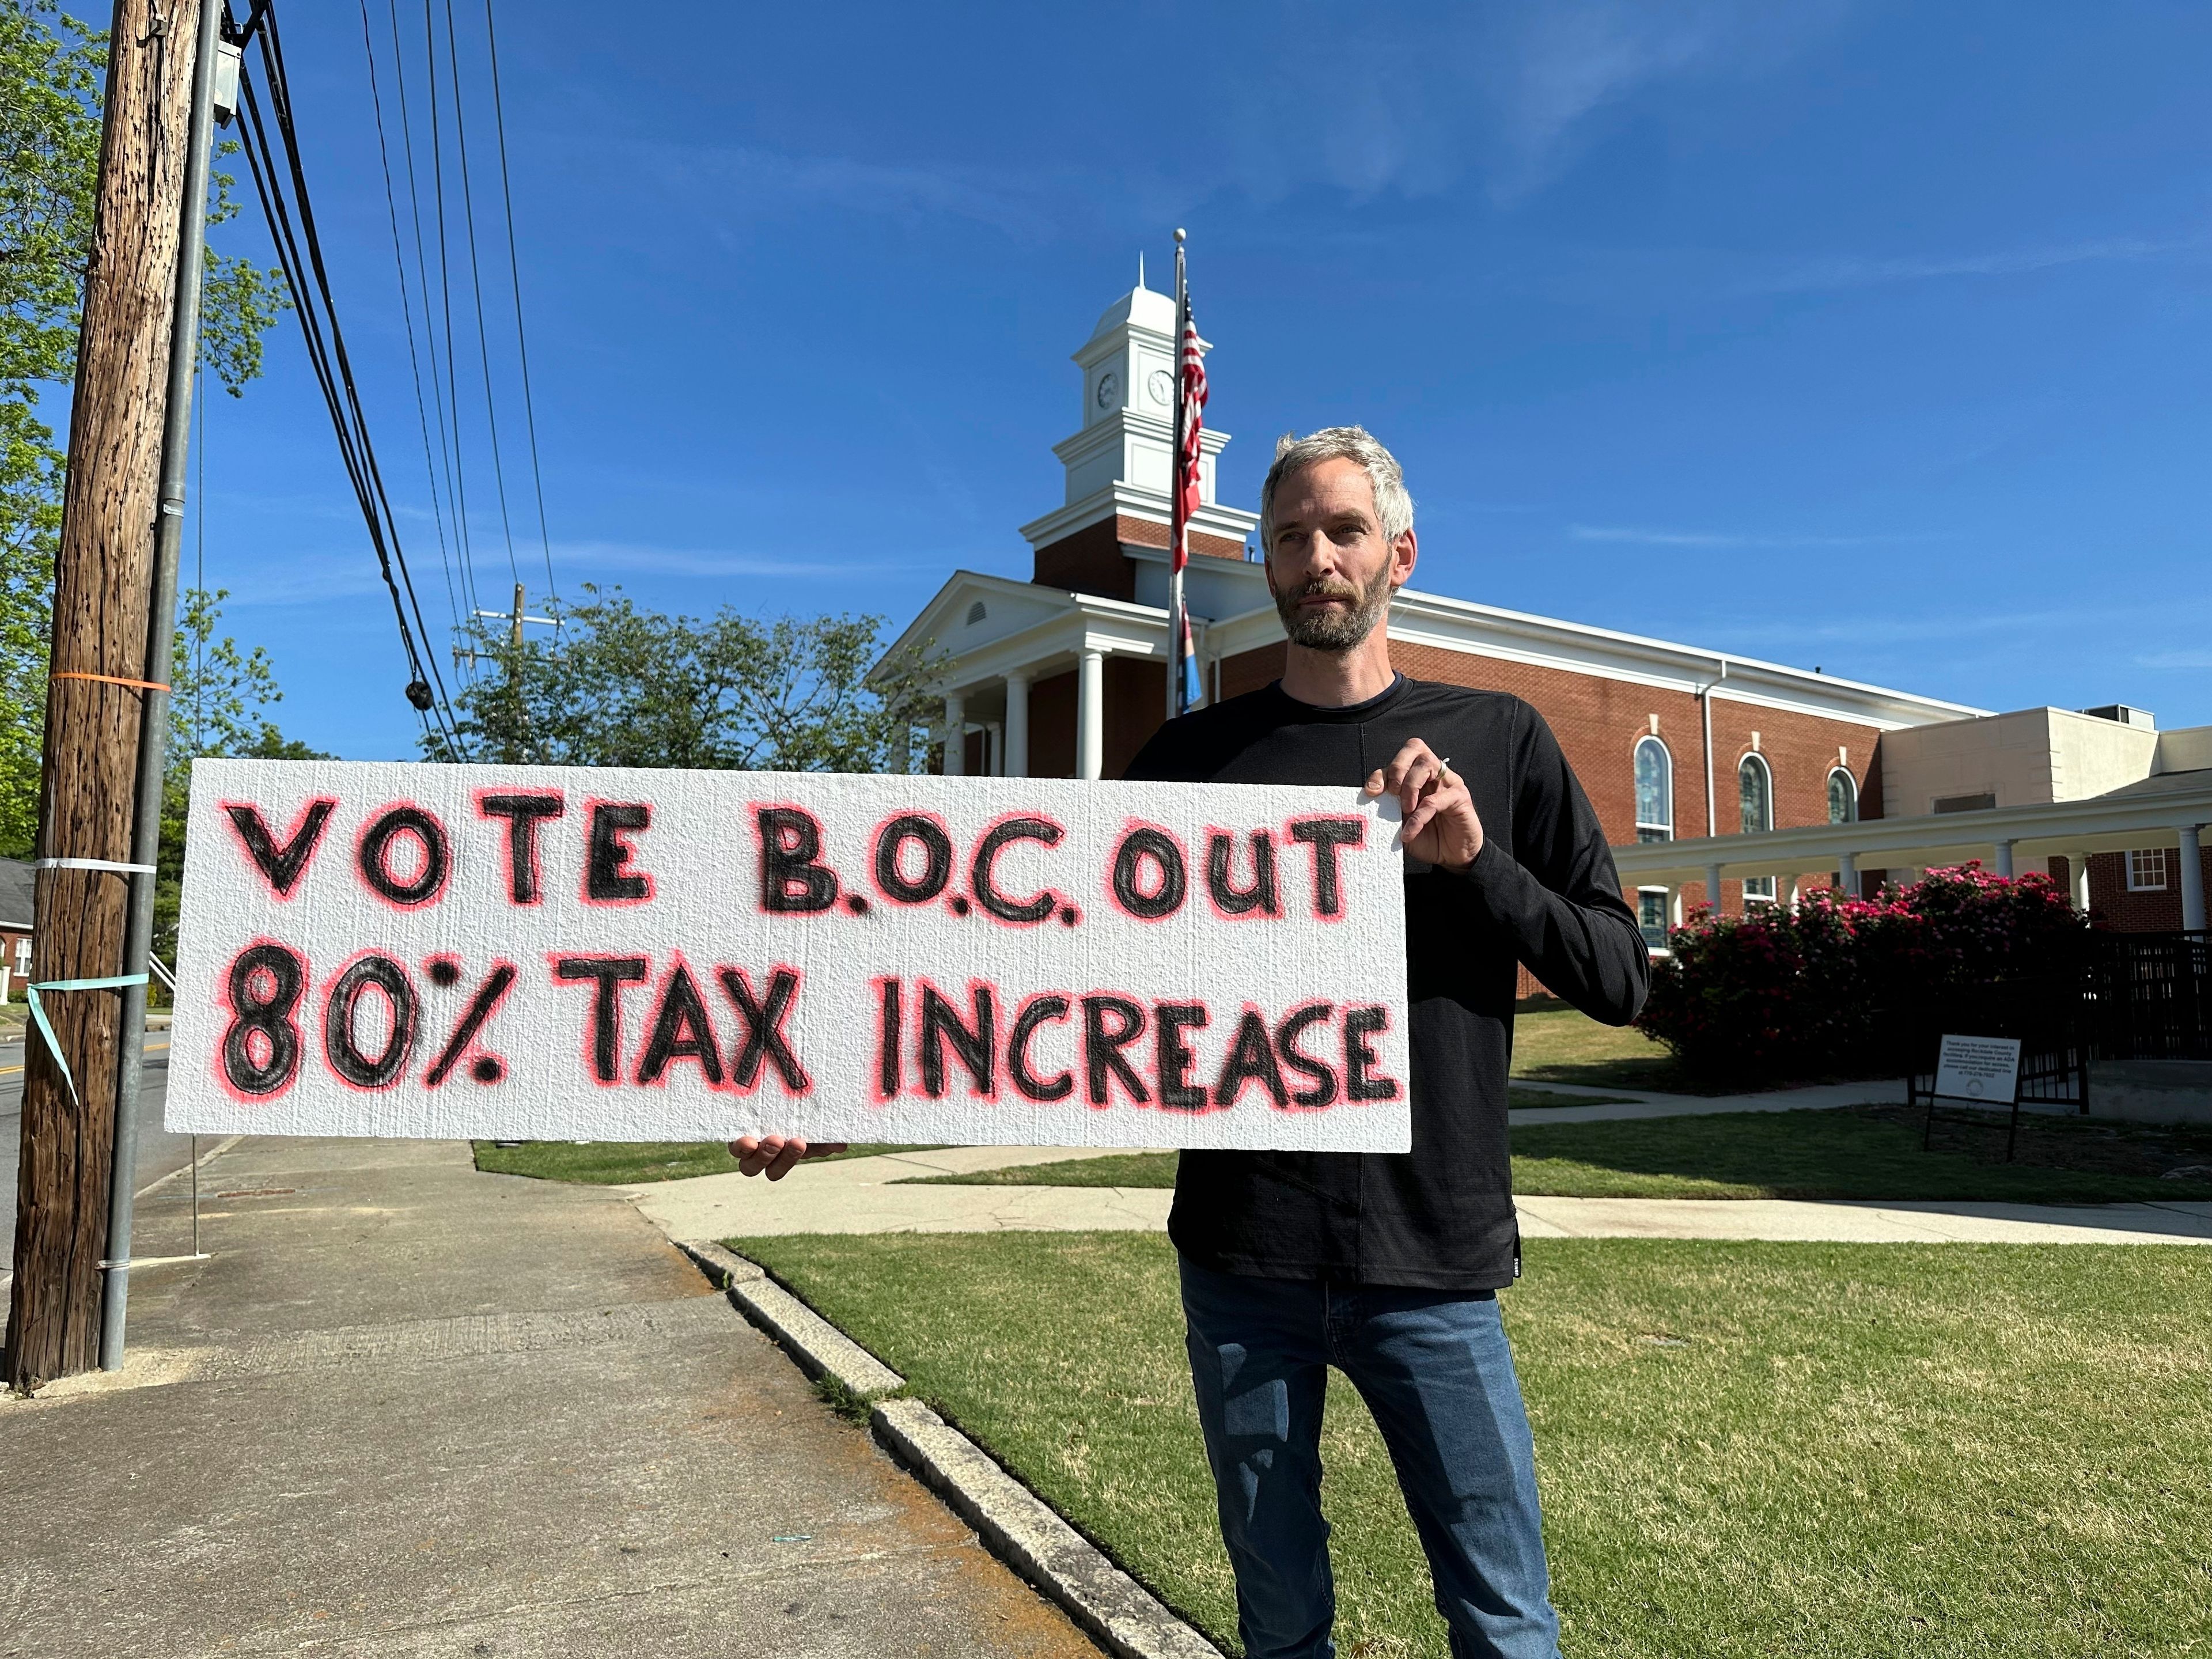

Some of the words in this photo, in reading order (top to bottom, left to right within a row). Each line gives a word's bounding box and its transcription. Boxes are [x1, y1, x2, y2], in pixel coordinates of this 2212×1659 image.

[225, 793, 653, 905] VOTE
[757, 806, 1077, 926] B.O.C.
[1112, 819, 1364, 919] OUT
[222, 944, 517, 1096] 80%
[558, 957, 808, 1091] TAX
[881, 979, 1398, 1111] INCREASE
